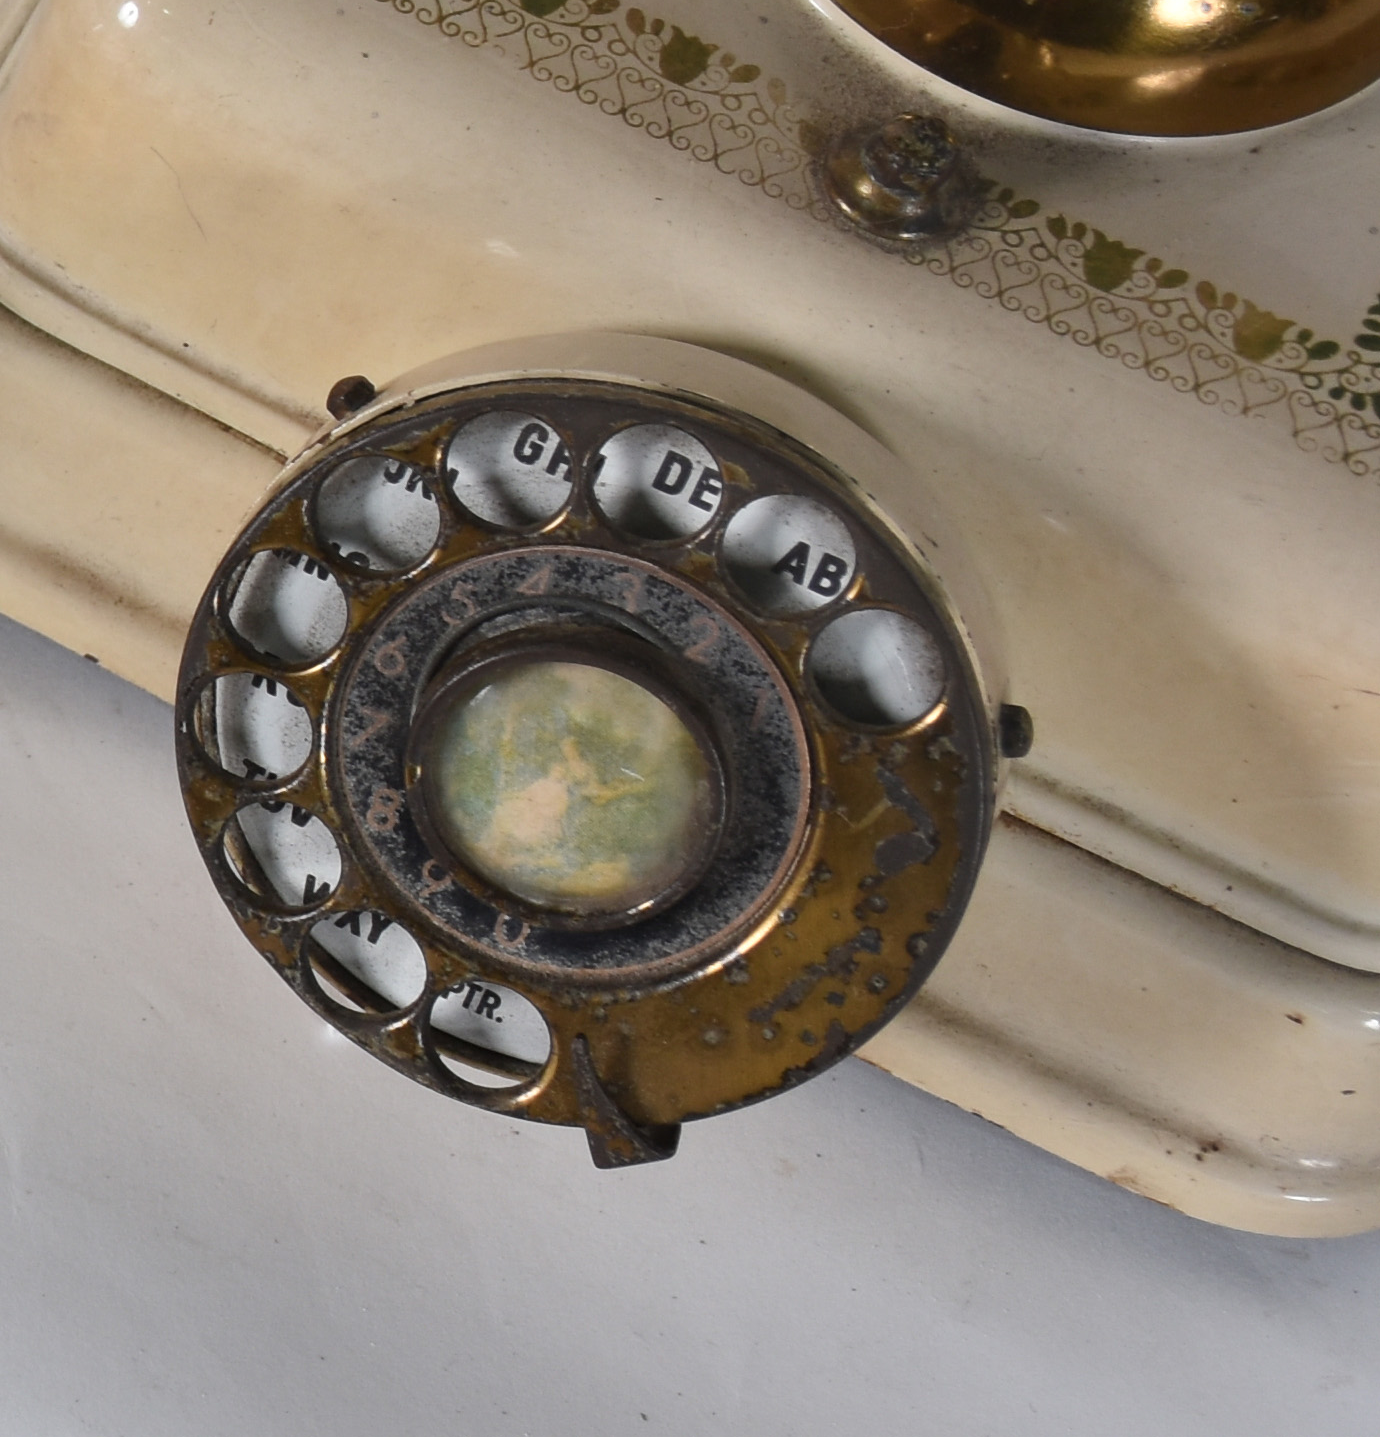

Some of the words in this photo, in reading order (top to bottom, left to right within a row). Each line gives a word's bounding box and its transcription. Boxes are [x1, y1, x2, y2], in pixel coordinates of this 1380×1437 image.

[772, 541, 848, 597] AB
[442, 581, 478, 627] 5
[374, 634, 407, 678] 6
[684, 617, 720, 665] 2
[351, 705, 391, 749] 7
[366, 787, 404, 832] 8
[418, 858, 455, 898] 9
